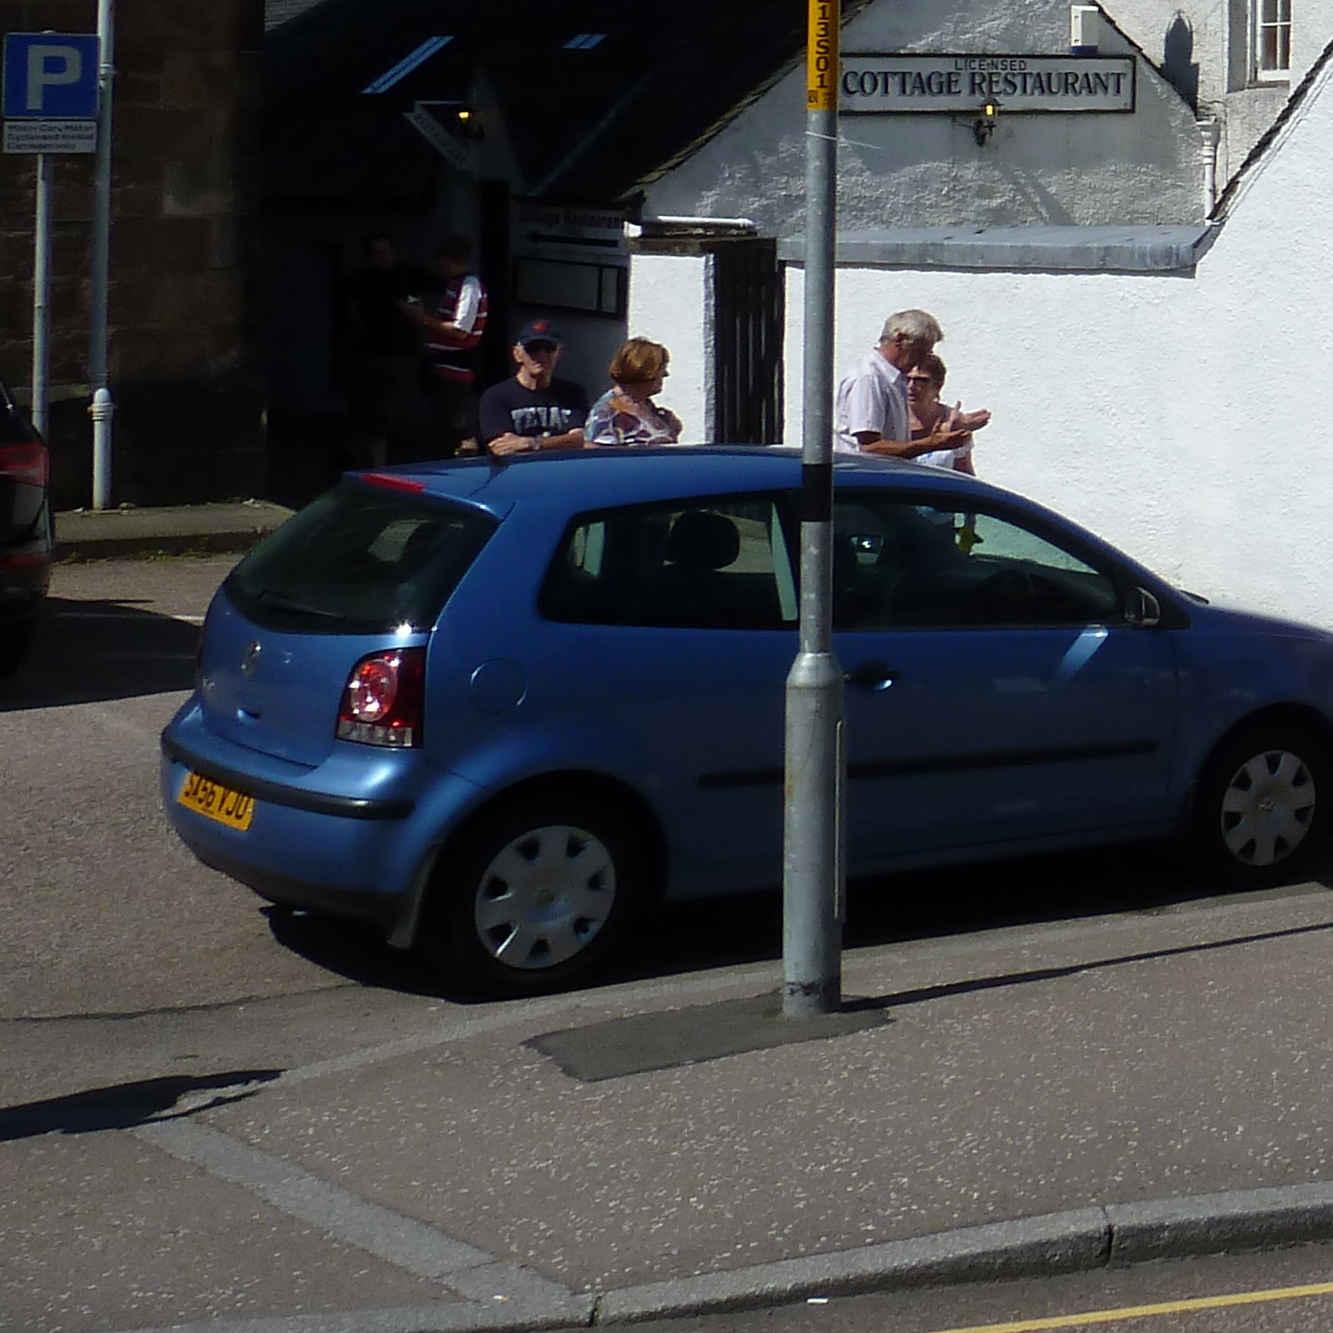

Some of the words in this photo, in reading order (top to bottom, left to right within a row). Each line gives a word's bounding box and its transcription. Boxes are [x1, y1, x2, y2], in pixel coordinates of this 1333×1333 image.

[26, 44, 82, 110] P
[955, 59, 1027, 72] LICENSED
[842, 71, 962, 97] COTTAGE
[968, 71, 1127, 98] RESTAURANT
